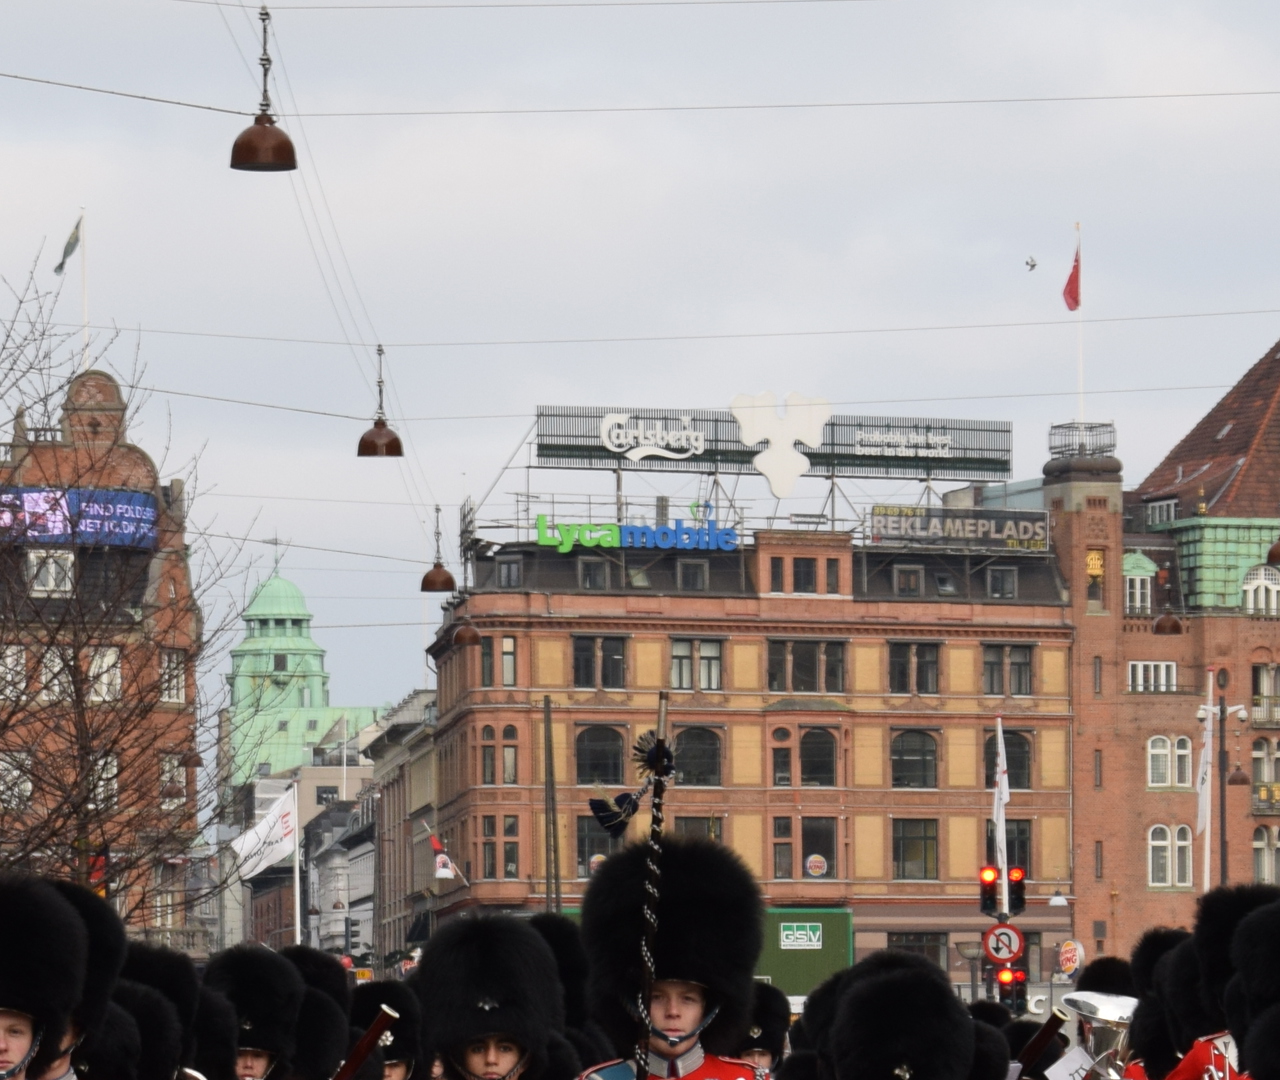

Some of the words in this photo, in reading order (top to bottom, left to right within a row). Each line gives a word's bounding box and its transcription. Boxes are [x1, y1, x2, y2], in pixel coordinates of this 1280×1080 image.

[600, 413, 705, 462] Carlsberg
[855, 431, 907, 447] Probably
[908, 433, 926, 444] the
[927, 433, 951, 444] best
[536, 514, 738, 553] Lycamobile
[873, 516, 1046, 541] REKLAMEPLADS
[783, 931, 820, 943] GSV
